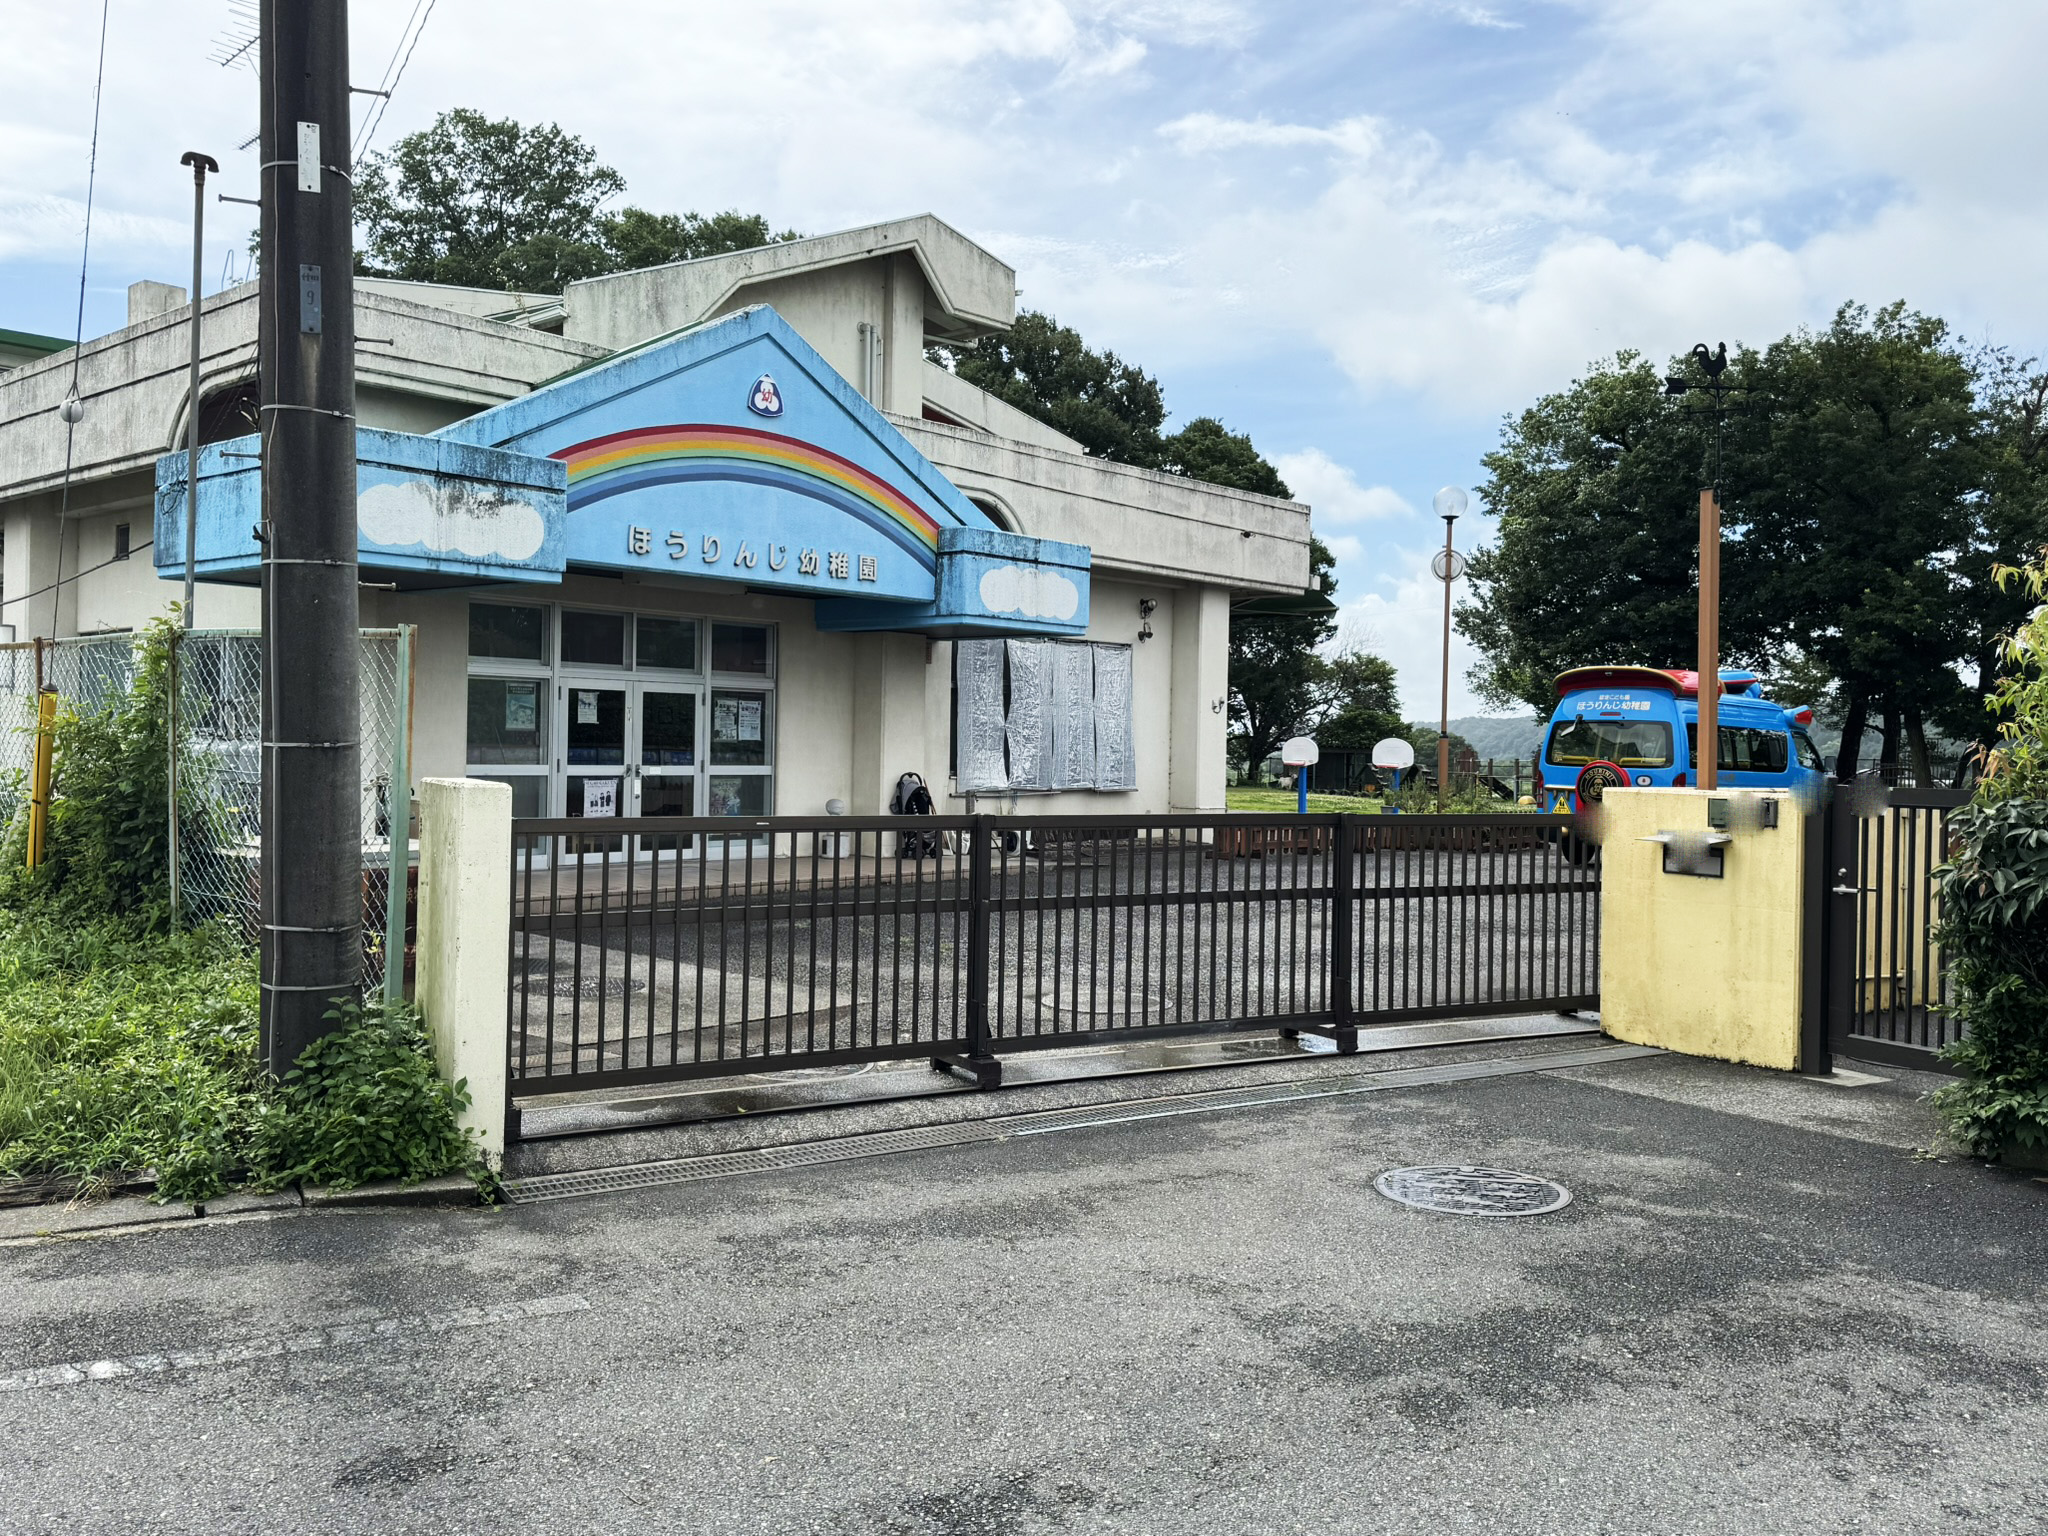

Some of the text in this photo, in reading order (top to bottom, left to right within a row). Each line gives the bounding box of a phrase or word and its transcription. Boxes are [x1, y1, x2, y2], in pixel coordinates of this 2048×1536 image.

[628, 525, 878, 582] ほうりんじ幼稚園
[1576, 701, 1651, 711] ほうりんじ幼稚園
